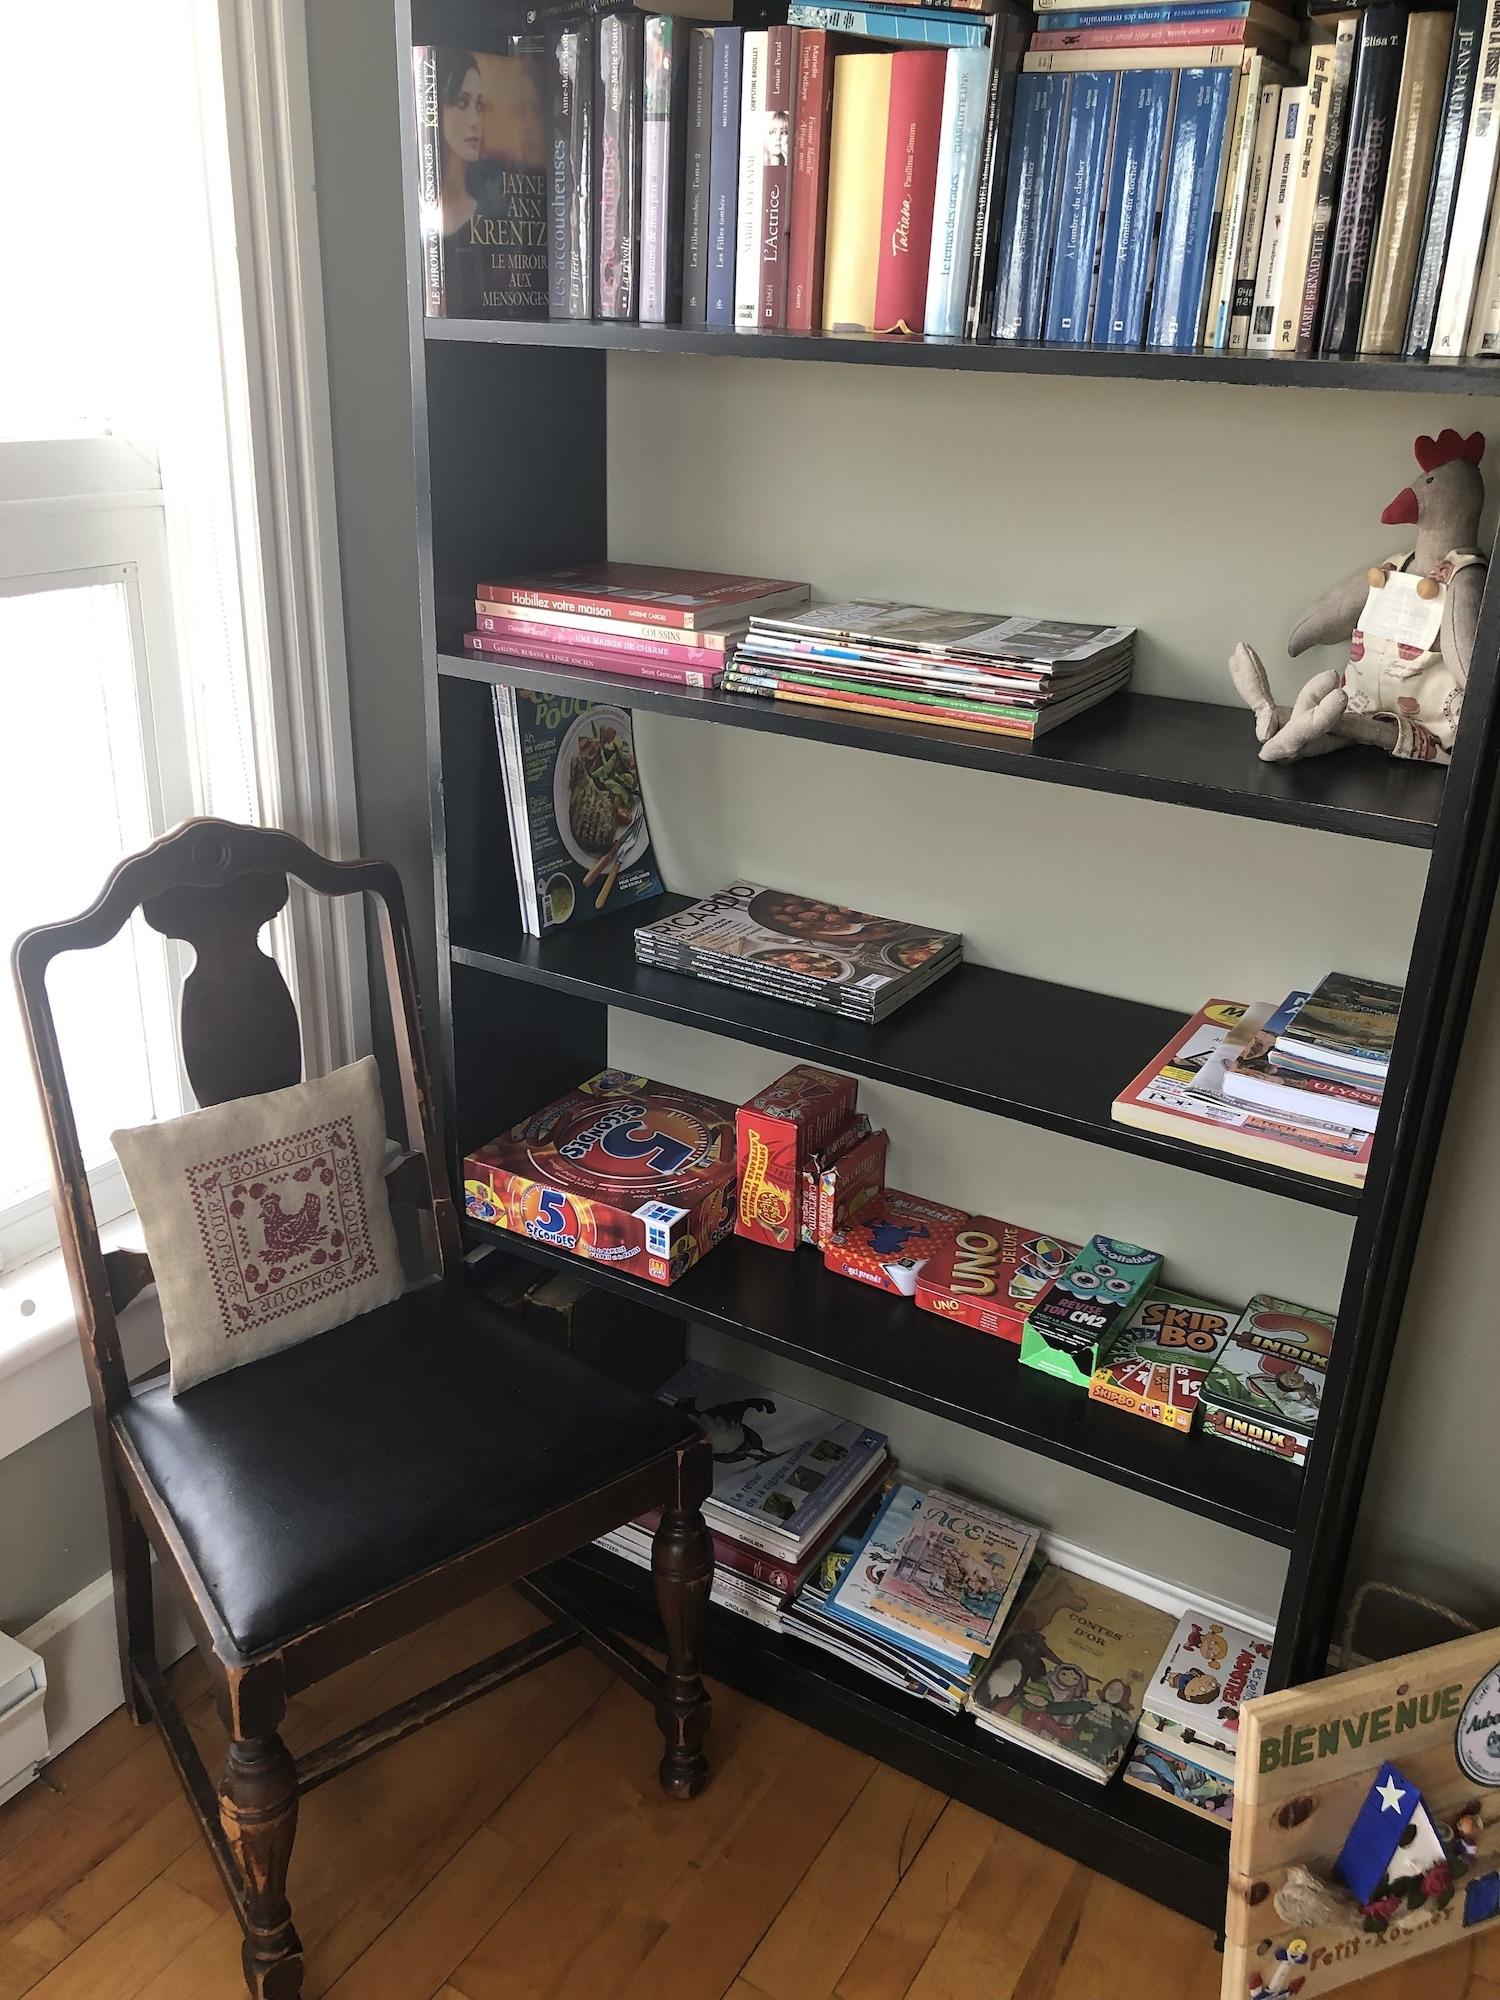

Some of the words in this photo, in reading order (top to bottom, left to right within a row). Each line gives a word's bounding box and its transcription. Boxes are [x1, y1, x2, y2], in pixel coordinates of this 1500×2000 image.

[1079, 15, 1123, 25] retrouvailles
[1124, 13, 1136, 24] des
[1136, 10, 1161, 22] temps
[1161, 11, 1172, 21] Le
[561, 27, 570, 61] Sicotte
[611, 21, 619, 54] Sicotte
[1362, 36, 1388, 48] Elisa
[1388, 35, 1399, 46] T.
[750, 46, 759, 79] BROUILLET
[773, 41, 782, 66] Portal
[803, 44, 811, 69] Trolet
[810, 44, 819, 79] Marielle
[1314, 55, 1330, 72] les
[424, 58, 437, 129] KRENTZ
[750, 79, 758, 112] CHRYSTINE
[773, 67, 781, 95] Louise
[801, 69, 810, 101] Ndiaye
[960, 72, 969, 95] LINK
[1309, 73, 1328, 109] Berger
[695, 85, 703, 128] MICHELINE
[799, 119, 807, 145] Afrique
[906, 122, 916, 153] Simons
[955, 95, 967, 154] CHARLOTTE
[1325, 120, 1341, 156] Refuge
[806, 142, 815, 177] blanche
[903, 152, 914, 188] Paullina
[1283, 152, 1291, 175] NICCI
[1323, 161, 1334, 175] Le
[502, 171, 546, 196] JAYNE
[947, 173, 960, 208] orages
[1023, 160, 1035, 195] clocher
[1072, 159, 1085, 194] clocher
[1125, 159, 1138, 196] clocher
[1250, 167, 1261, 205] ALBERT
[1278, 176, 1288, 204] FRENCH
[507, 196, 542, 219] ANN
[552, 138, 566, 270] accoucheuses
[600, 135, 615, 271] accoucheuses
[1021, 195, 1031, 209] du
[1071, 196, 1081, 210] du
[1124, 196, 1134, 211] du
[1358, 194, 1375, 220] LE
[469, 214, 547, 247] KRENTZ
[764, 183, 780, 263] L'Actrice
[892, 193, 912, 257] Tatiana
[945, 210, 954, 229] des
[973, 211, 985, 257] RICHARD
[1067, 212, 1079, 250] l'ombre
[1246, 208, 1256, 243] ADRIEN
[691, 228, 699, 251] Filles
[717, 227, 725, 251] Filles
[942, 231, 953, 262] temps
[1349, 223, 1371, 284] DANS
[491, 253, 507, 270] LE
[508, 254, 549, 270] MIROIR
[570, 250, 580, 280] fierté
[619, 235, 631, 274] révolte
[690, 253, 698, 268] Les
[716, 253, 724, 268] Les
[1065, 251, 1075, 260] À
[1268, 238, 1278, 274] Ténébreux
[429, 250, 440, 291] MIROIR
[510, 273, 532, 288] AUX
[619, 275, 631, 292] La
[432, 293, 441, 306] LE
[482, 291, 549, 307] MENSONGES
[552, 272, 566, 308] Les
[570, 283, 579, 299] La
[766, 284, 774, 306] HMH
[1264, 275, 1273, 299] samedi
[1300, 236, 1328, 340] MARIE-BERNADETTE
[511, 591, 550, 609] Habillez
[551, 599, 575, 613] votre
[577, 603, 612, 617] maison
[575, 635, 593, 644] UNE
[593, 637, 622, 648] MAISON
[623, 642, 636, 651] DE
[636, 643, 670, 656] CHARME
[641, 626, 681, 641] COUSSINS
[521, 647, 545, 658] RUBANS
[551, 653, 570, 662] LINGE
[571, 657, 595, 667] ANCIEN
[525, 743, 535, 754] les
[533, 737, 557, 753] voisins!
[650, 886, 755, 936] RICARDO
[558, 1103, 648, 1160] SECONDES
[227, 1138, 325, 1181] BONJOUR
[600, 1120, 696, 1175] 5
[748, 1140, 758, 1180] ATTRAPER
[744, 1180, 752, 1190] LE
[754, 1171, 762, 1182] LE
[335, 1156, 363, 1251] BONJOUR
[535, 1188, 567, 1233] 5
[748, 1182, 759, 1217] PREMIER
[895, 1198, 914, 1212] qui
[914, 1203, 958, 1224] prend!
[207, 1197, 243, 1298] BONJOUR
[525, 1220, 576, 1249] SECONDES
[1002, 1228, 1018, 1265] DELUXE
[950, 1230, 1000, 1297] UNO
[1096, 1243, 1156, 1264] incollables
[257, 1266, 348, 1312] BONJOUR
[849, 1266, 860, 1277] qui
[859, 1268, 882, 1284] prend!
[932, 1299, 960, 1312] UNO
[1043, 1303, 1069, 1317] TON
[1069, 1311, 1107, 1328] CM2
[1058, 1297, 1104, 1315] RÉVISE
[1156, 1325, 1218, 1353] BO
[1251, 1336, 1329, 1367] INDIX
[1176, 1367, 1189, 1376] 12
[1224, 1416, 1286, 1448] INDIX
[732, 1490, 744, 1503] Le
[742, 1472, 763, 1495] retour
[746, 1495, 757, 1508] de
[762, 1463, 791, 1491] cigogne
[922, 1507, 985, 1541] ACE
[738, 1533, 765, 1550] GROLIER
[724, 1600, 750, 1617] GROLIER
[1068, 1612, 1123, 1641] CONTES
[1073, 1627, 1106, 1647] D'OR
[1221, 1648, 1257, 1707] MONSTRES
[1258, 1682, 1463, 1774] BIENVENUE
